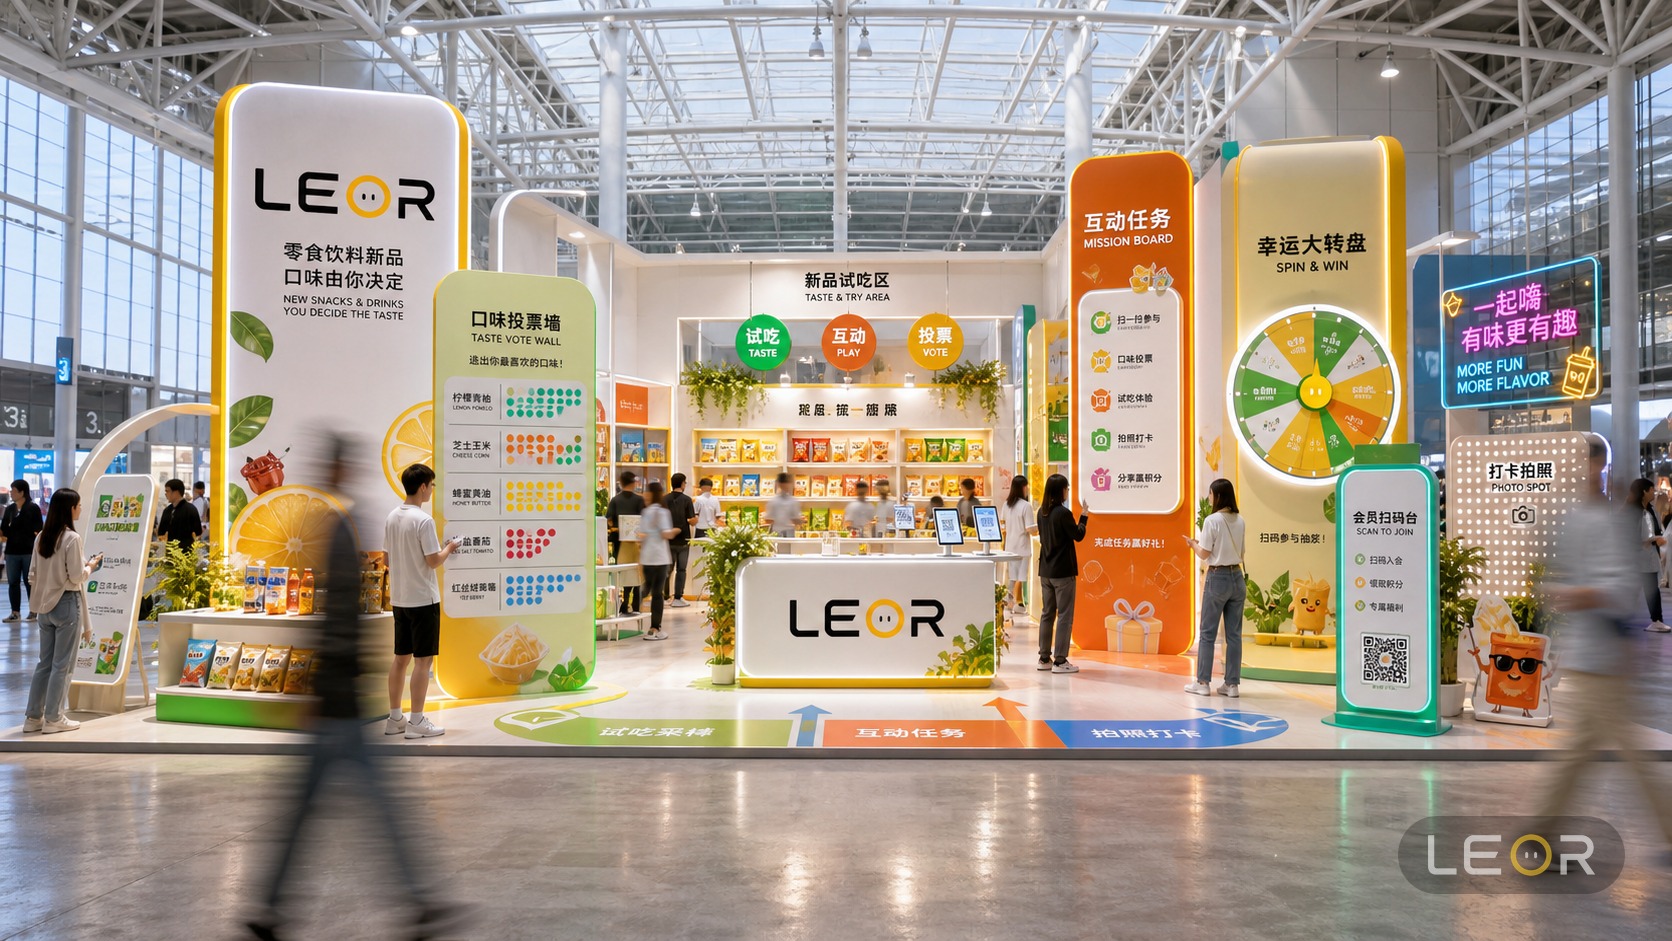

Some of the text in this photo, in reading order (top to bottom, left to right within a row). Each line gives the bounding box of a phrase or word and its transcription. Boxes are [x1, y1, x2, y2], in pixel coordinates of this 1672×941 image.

[255, 168, 435, 221] LEOR
[1084, 208, 1171, 233] 互动任务
[1084, 233, 1174, 248] MISSION BOARD
[1257, 232, 1367, 256] 幸运大转盘
[283, 242, 404, 266] 零食饮料新品
[1276, 260, 1349, 273] SPIN & WIN
[284, 268, 404, 291] 口味由你决定
[804, 272, 890, 289] 新品试吃区
[283, 295, 404, 309] NEW SNACKS & DRINKS
[805, 293, 890, 302] TASTE & TRY AREA
[283, 307, 404, 321] YOU DECIDE THE TASTE
[471, 311, 561, 332] 口味投票墙
[746, 327, 780, 345] 试吃
[832, 327, 866, 345] 互动
[918, 326, 953, 345] 投票
[1461, 308, 1578, 353] 有味更有趣
[471, 333, 561, 346] TASTE VOTE WALL
[748, 349, 778, 358] TASTE
[837, 349, 861, 358] PLAY
[923, 348, 948, 357] VOTE
[1457, 357, 1523, 378] MORE FUN
[1457, 371, 1550, 394] MORE FLAVOR
[1117, 433, 1154, 443] 拍照打卡
[1488, 462, 1553, 480] 打卡拍照
[1491, 482, 1551, 492] PHOTO SPOT
[1352, 511, 1418, 525] 会员扫码台
[1356, 527, 1414, 536] SCAN TO JOIN
[789, 598, 945, 639] LEOR
[854, 728, 966, 738] 互动任务
[1091, 728, 1202, 739] 拍照打卡
